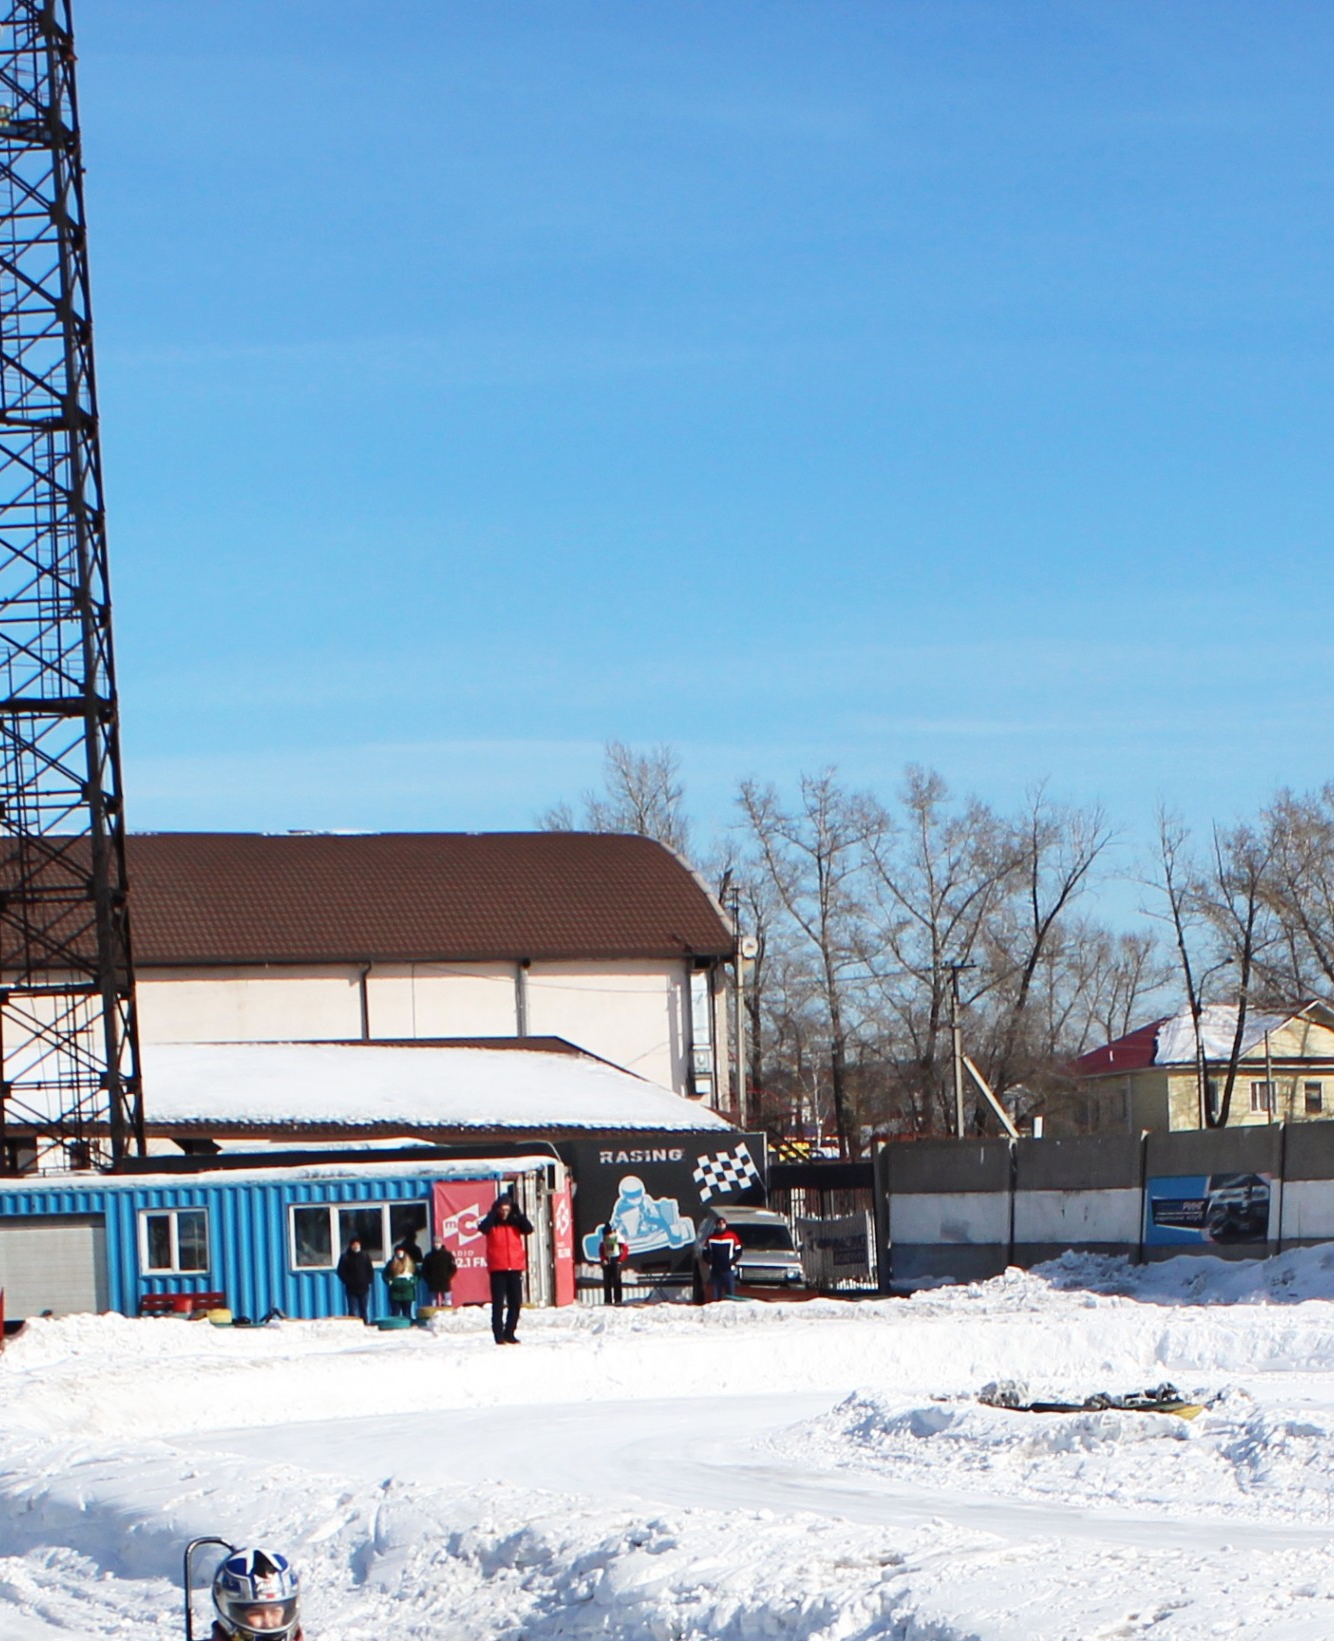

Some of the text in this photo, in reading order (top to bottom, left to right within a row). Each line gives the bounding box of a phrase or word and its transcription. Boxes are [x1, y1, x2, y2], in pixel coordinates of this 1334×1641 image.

[599, 1148, 685, 1165] RASING
[451, 1249, 474, 1257] ADIO
[455, 1257, 471, 1268] 2.1
